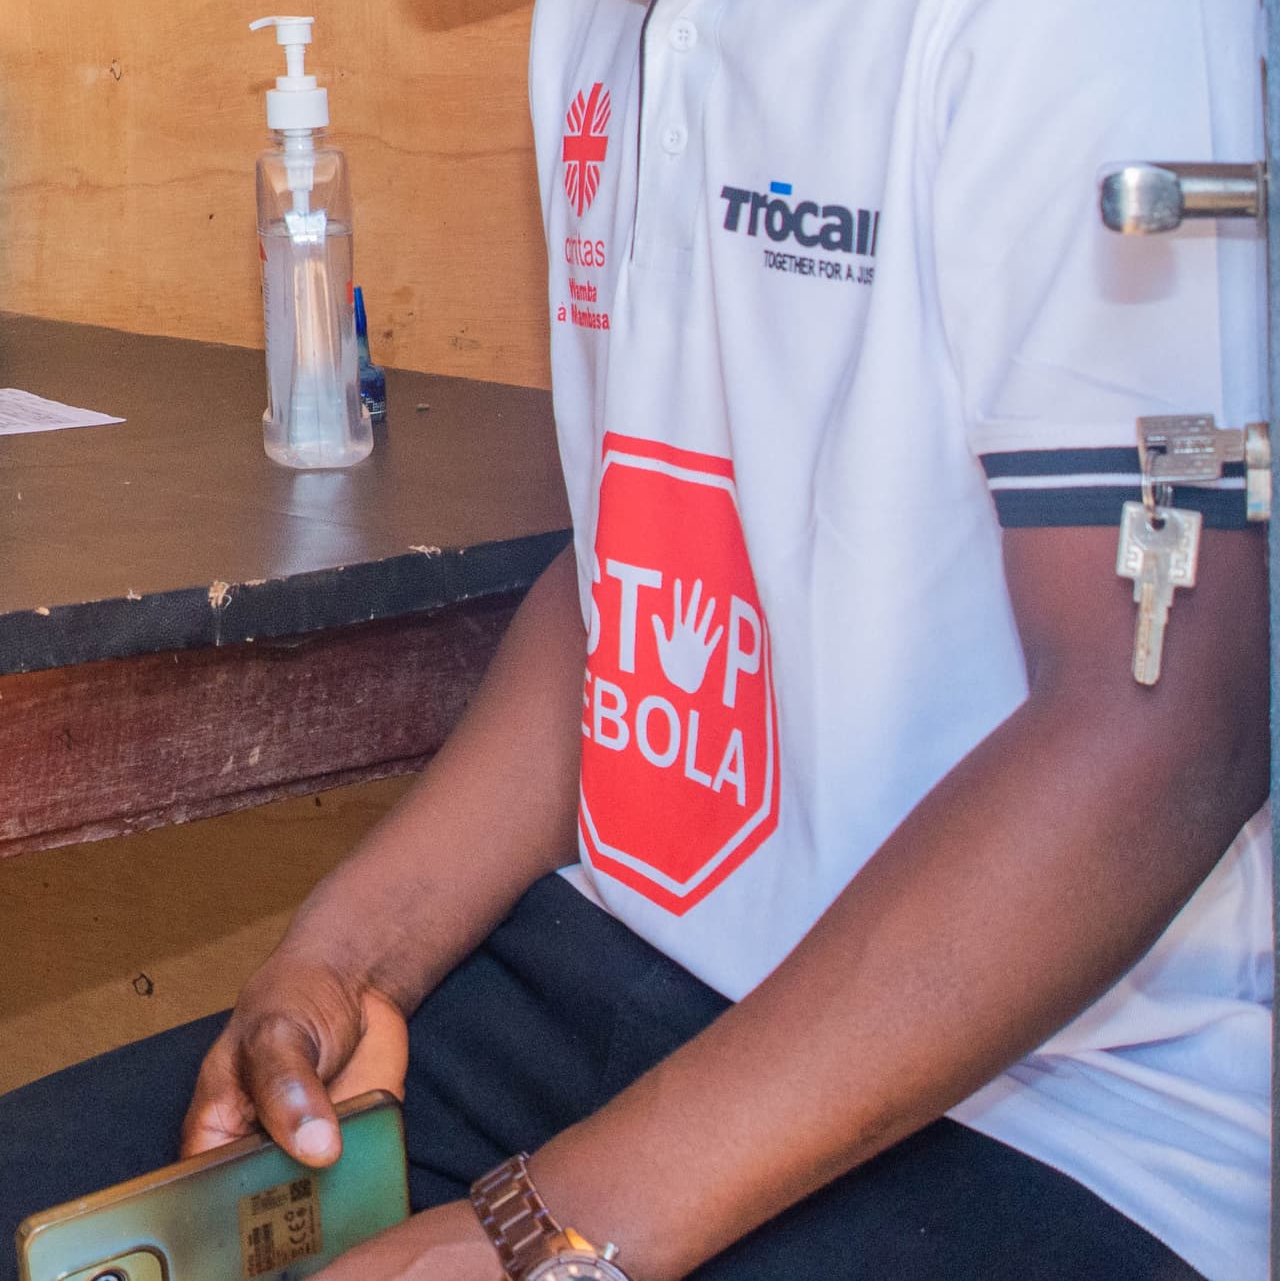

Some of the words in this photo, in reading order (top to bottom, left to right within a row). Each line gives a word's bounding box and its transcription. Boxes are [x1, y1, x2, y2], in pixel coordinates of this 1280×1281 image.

[764, 249, 816, 278] TOGETHER
[819, 260, 842, 281] FOR
[846, 265, 855, 282] A
